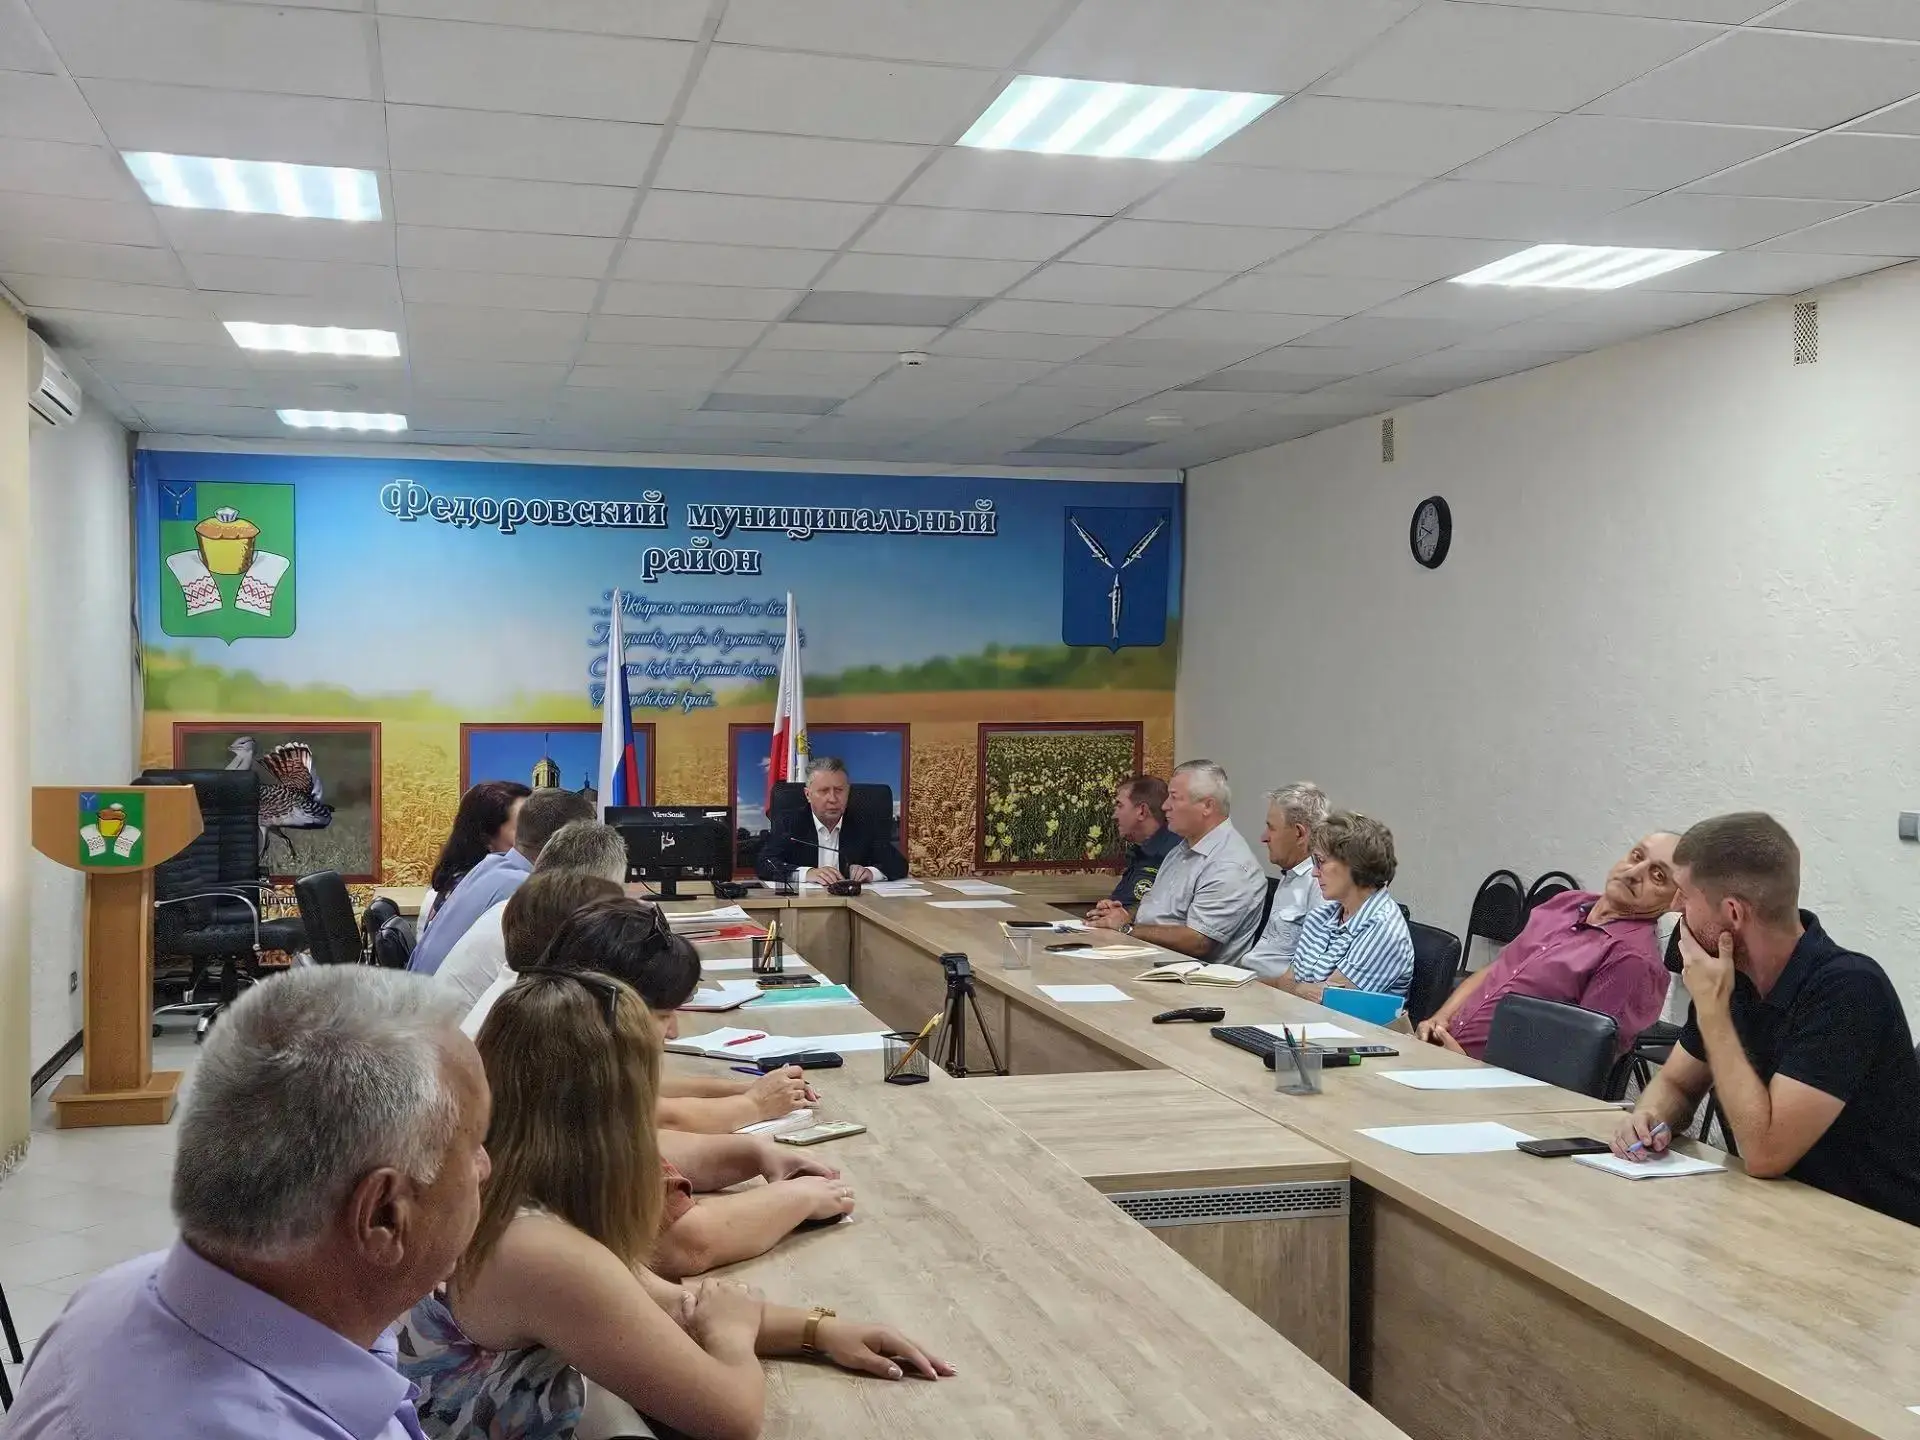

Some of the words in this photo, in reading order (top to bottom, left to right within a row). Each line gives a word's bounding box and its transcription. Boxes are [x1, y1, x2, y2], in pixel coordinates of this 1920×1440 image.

[380, 479, 668, 535] Федоровский
[687, 498, 999, 540] муниципальный
[641, 536, 762, 583] район
[646, 658, 672, 679] как
